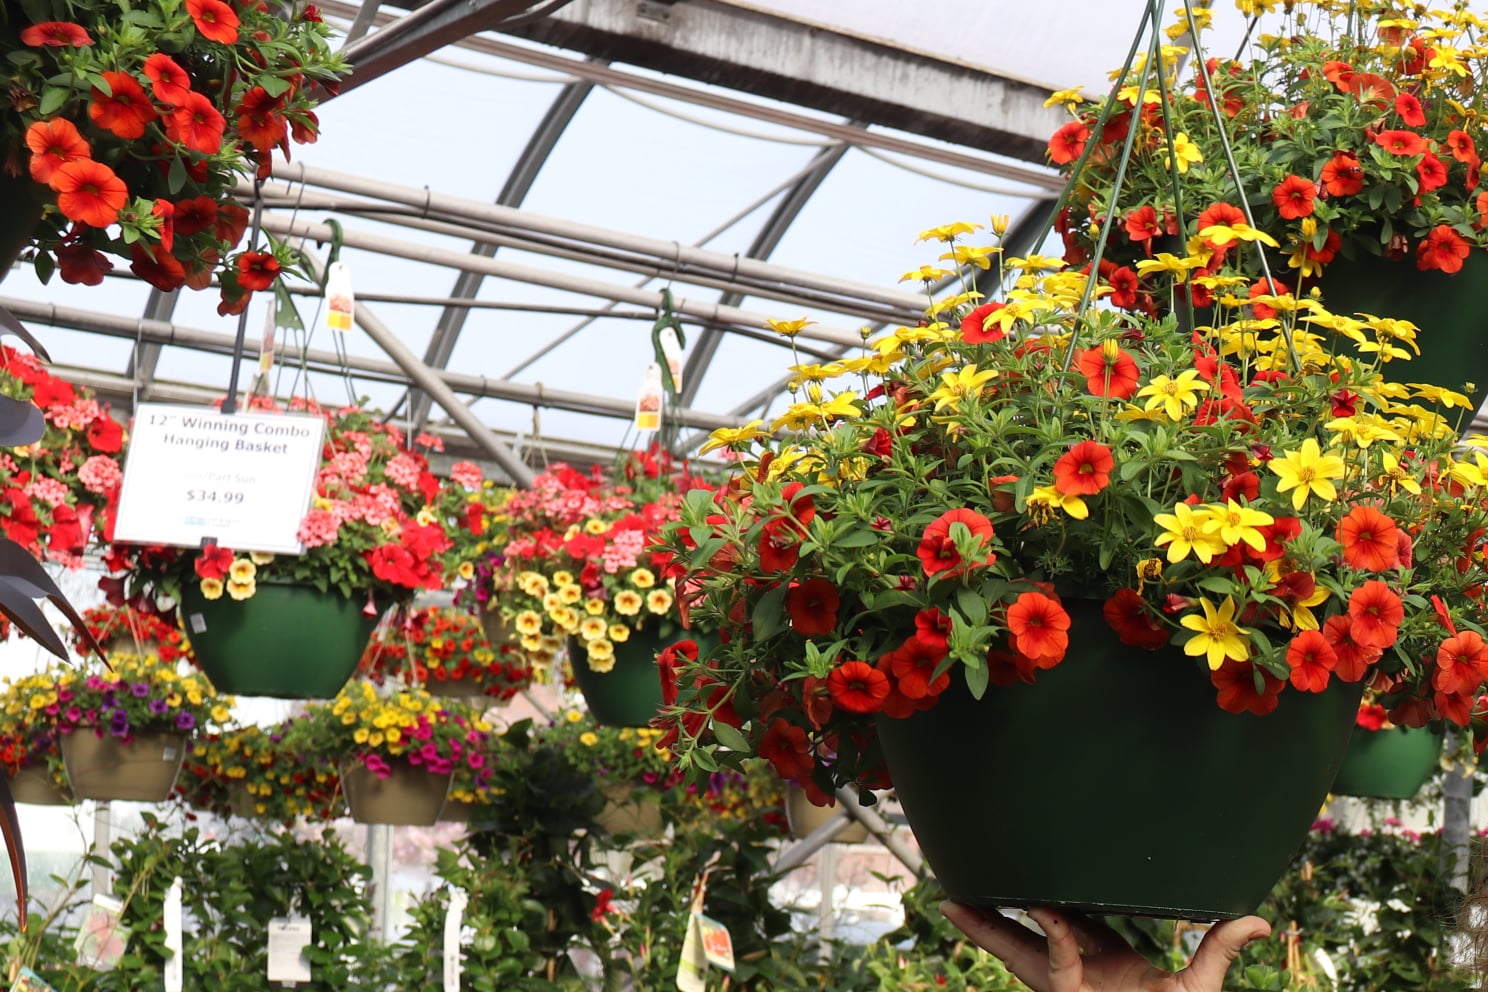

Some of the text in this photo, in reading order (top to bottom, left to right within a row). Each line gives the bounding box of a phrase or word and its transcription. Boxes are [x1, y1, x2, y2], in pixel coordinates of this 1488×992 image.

[149, 414, 310, 438] 12" Winning Combo
[163, 433, 288, 454] Hanging Basket
[187, 489, 244, 504] $34.99
